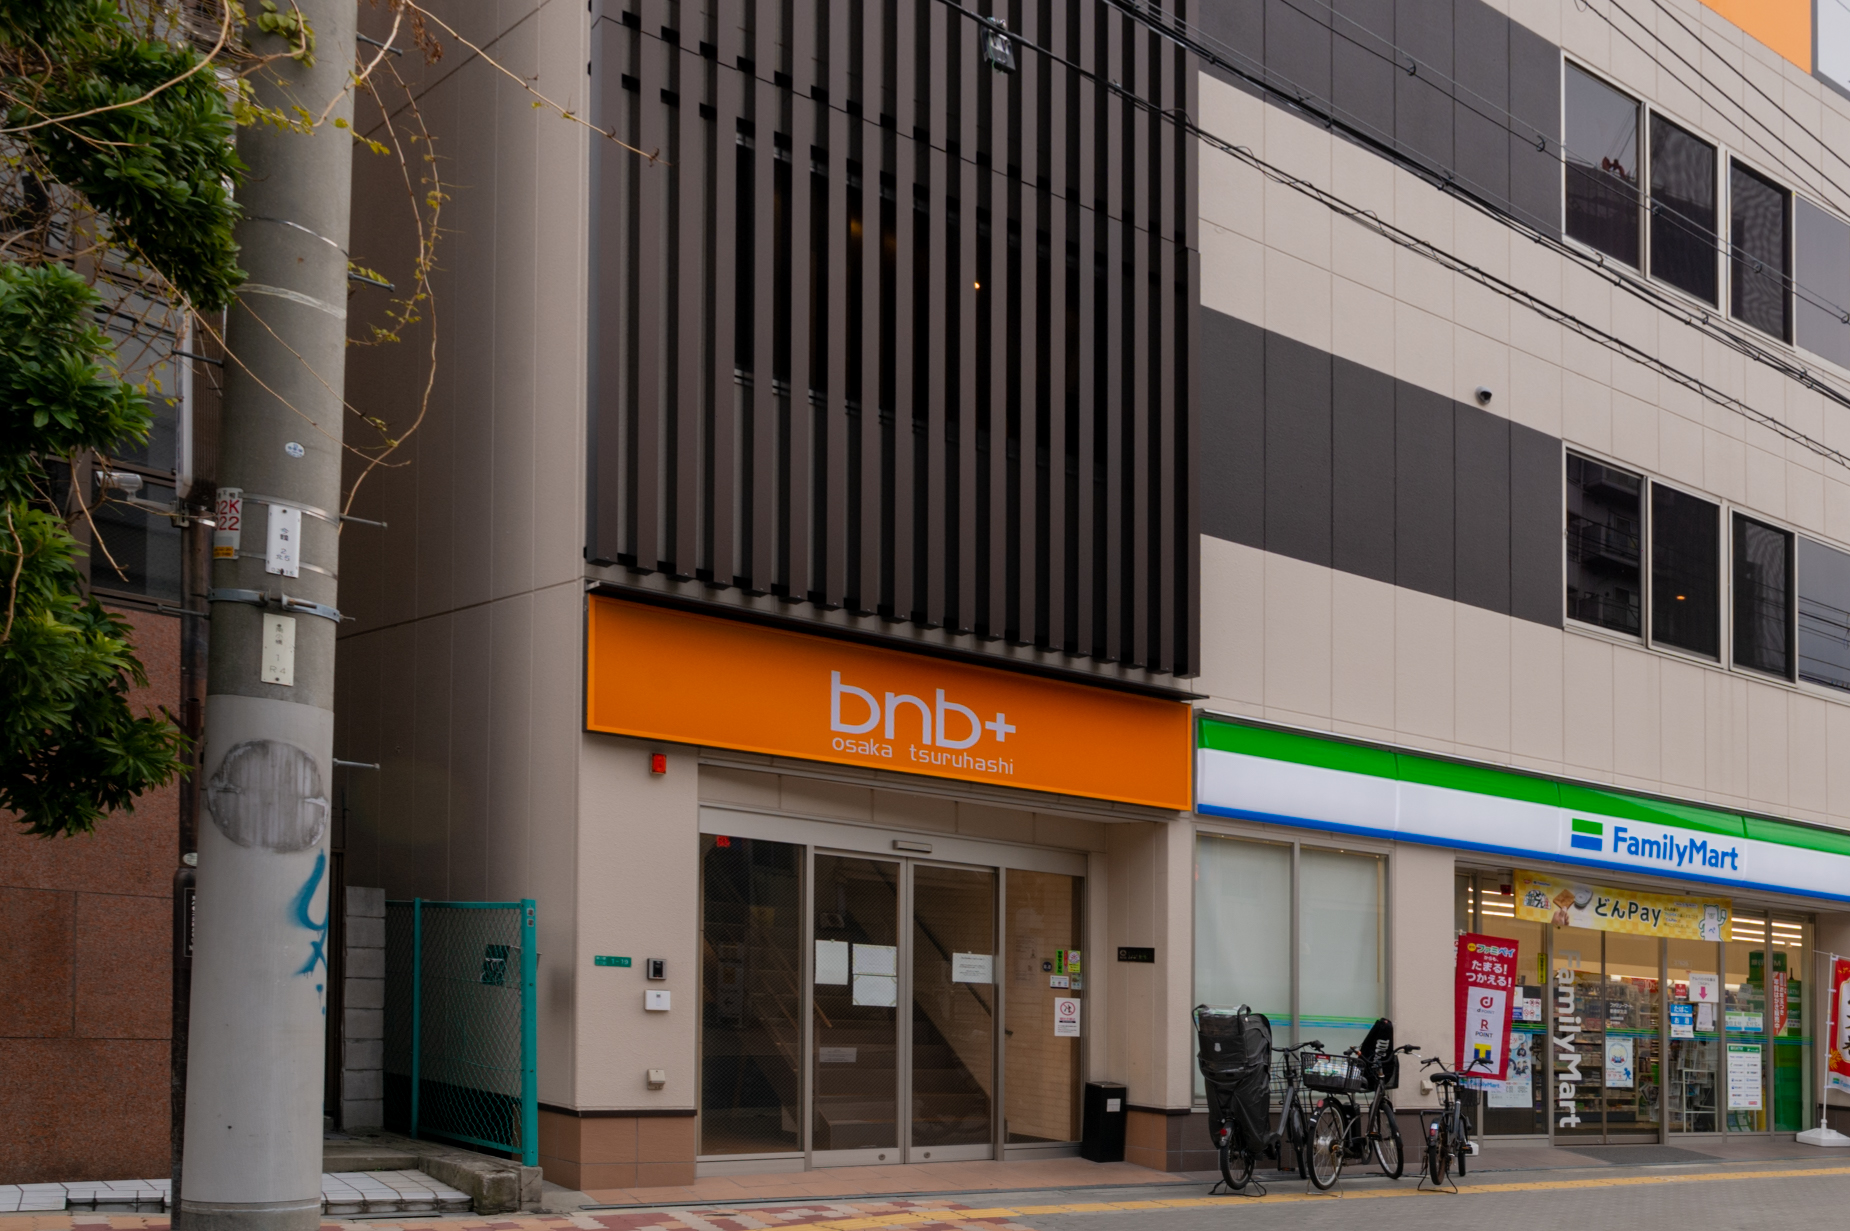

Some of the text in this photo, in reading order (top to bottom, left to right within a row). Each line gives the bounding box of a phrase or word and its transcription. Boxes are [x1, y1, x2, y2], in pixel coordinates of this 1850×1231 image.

[830, 670, 1016, 750] bnb+
[831, 736, 1014, 776] osaka tsuruhashi
[1613, 825, 1739, 871] FamilyMart
[1595, 896, 1662, 928] どんPay
[1476, 943, 1516, 958] ファミペイ
[1480, 1019, 1489, 1031] R
[1553, 949, 1582, 1128] FamilyMart
